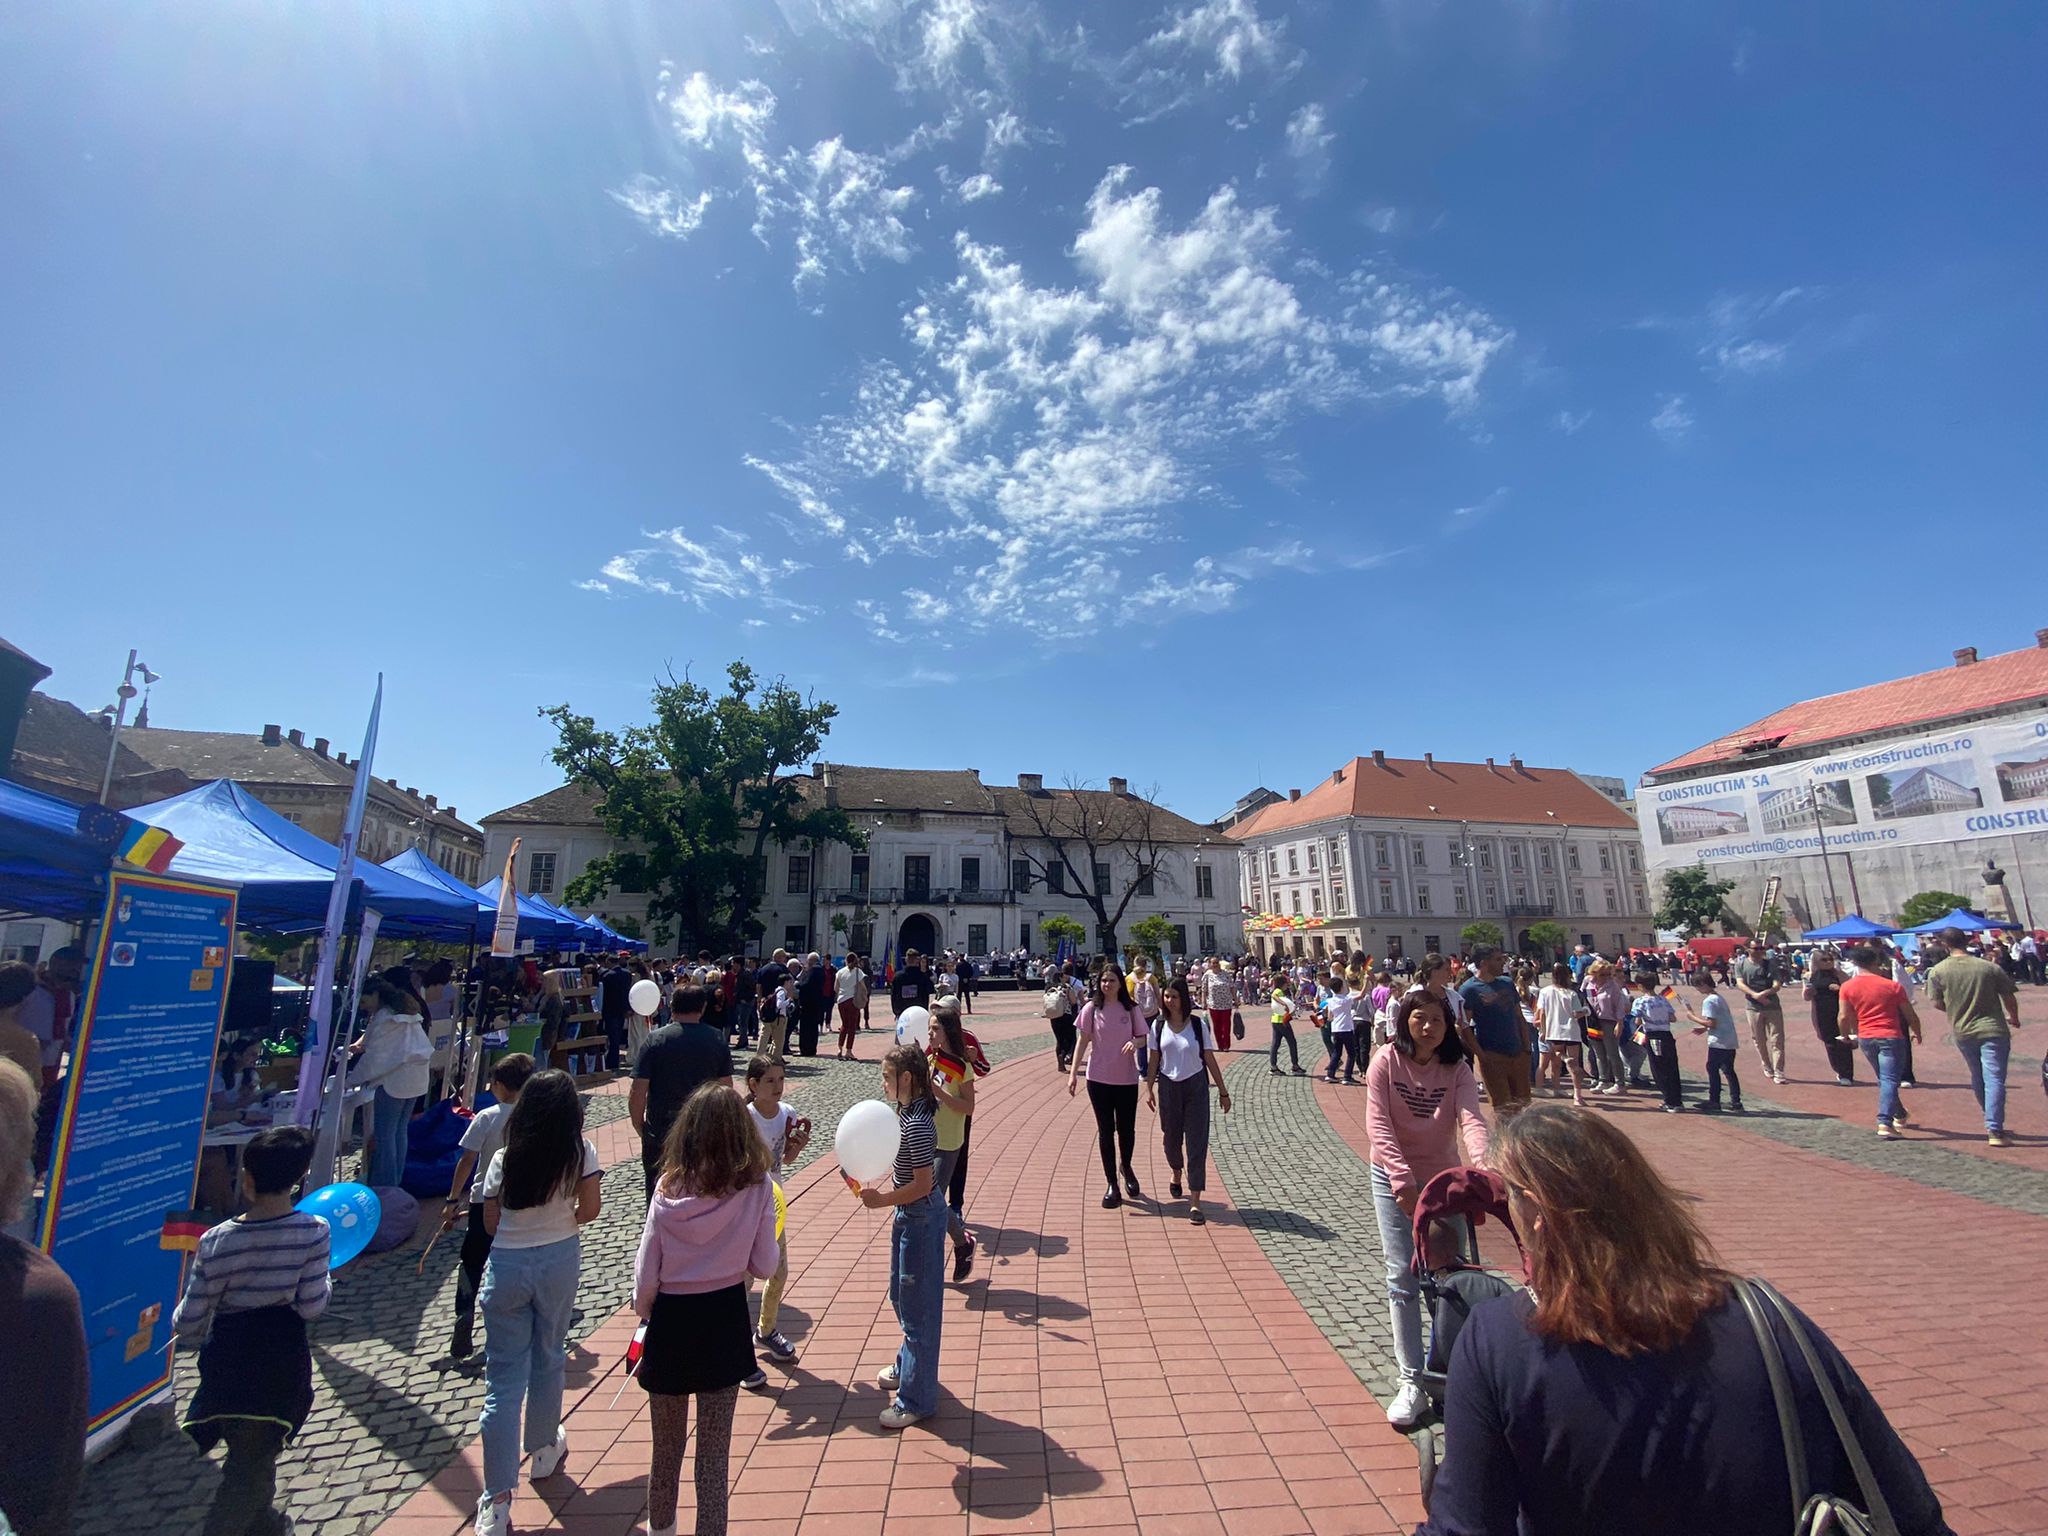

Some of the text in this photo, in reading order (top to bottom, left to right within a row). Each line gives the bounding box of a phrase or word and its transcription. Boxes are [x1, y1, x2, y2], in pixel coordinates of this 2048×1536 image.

[1812, 738, 1972, 775] www.constructim.ro
[1658, 774, 1770, 802] CONSTRUCTIM SA
[333, 1203, 358, 1229] 30
